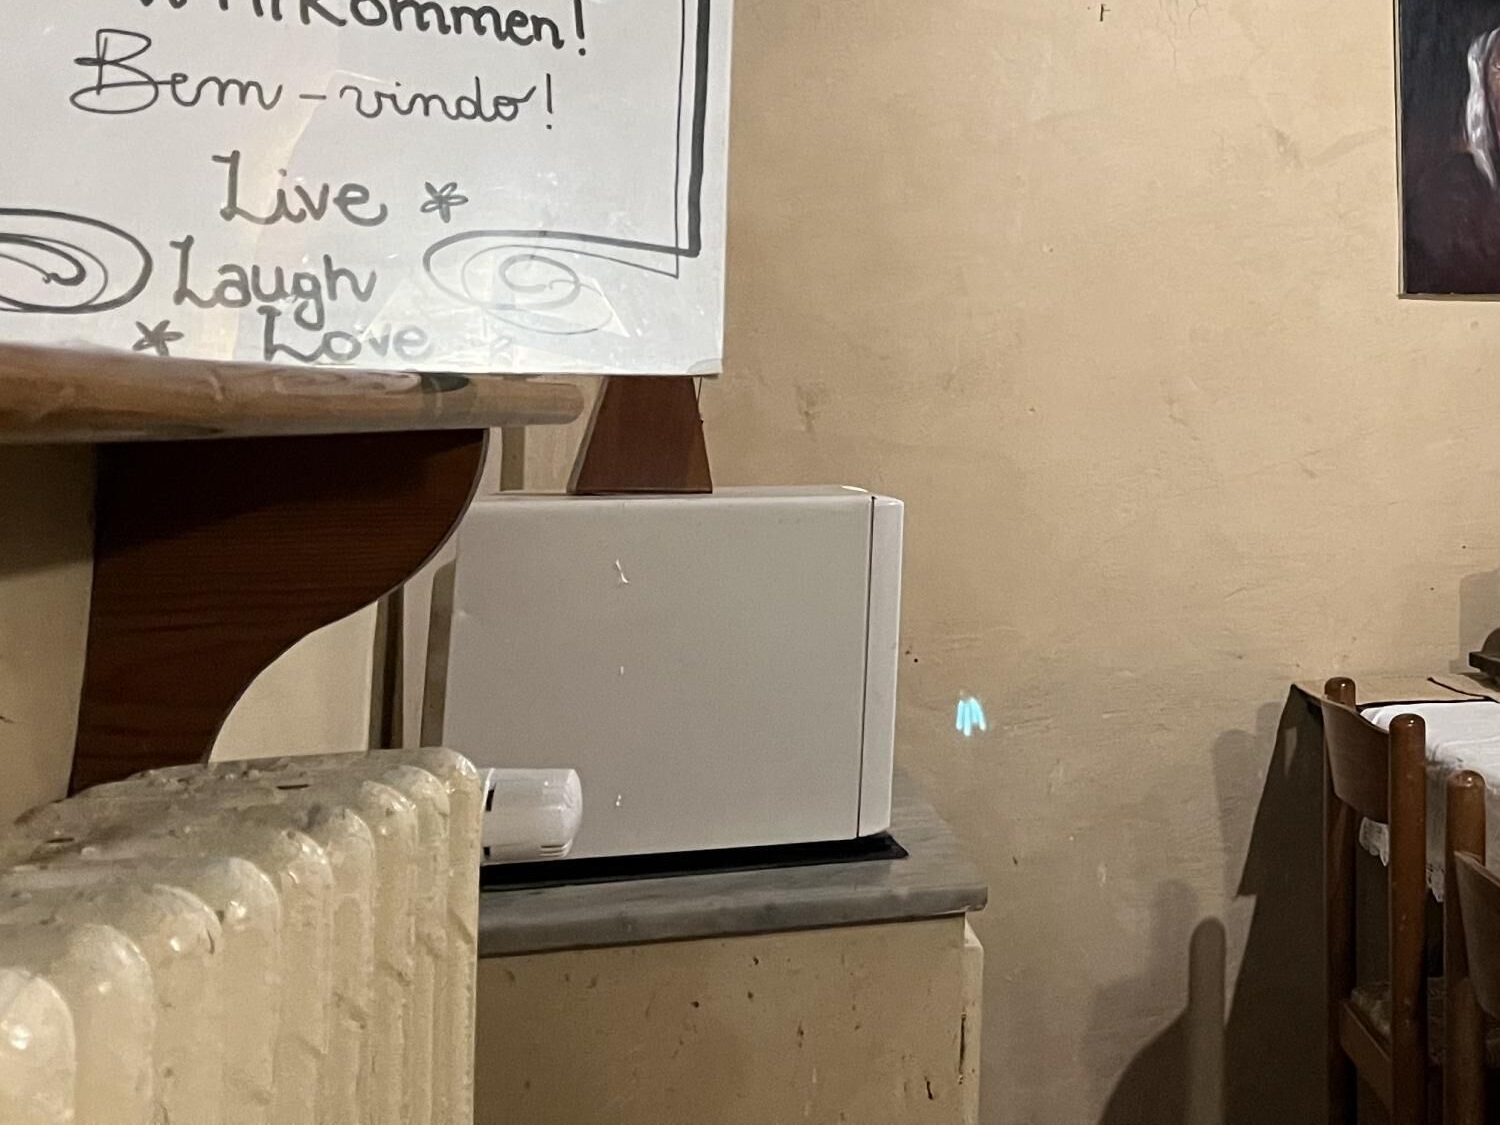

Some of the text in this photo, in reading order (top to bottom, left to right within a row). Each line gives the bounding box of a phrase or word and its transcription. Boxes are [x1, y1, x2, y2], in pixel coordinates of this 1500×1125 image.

[211, 150, 388, 227] Live
[169, 234, 378, 331] Laugh
[256, 305, 432, 363] Love
